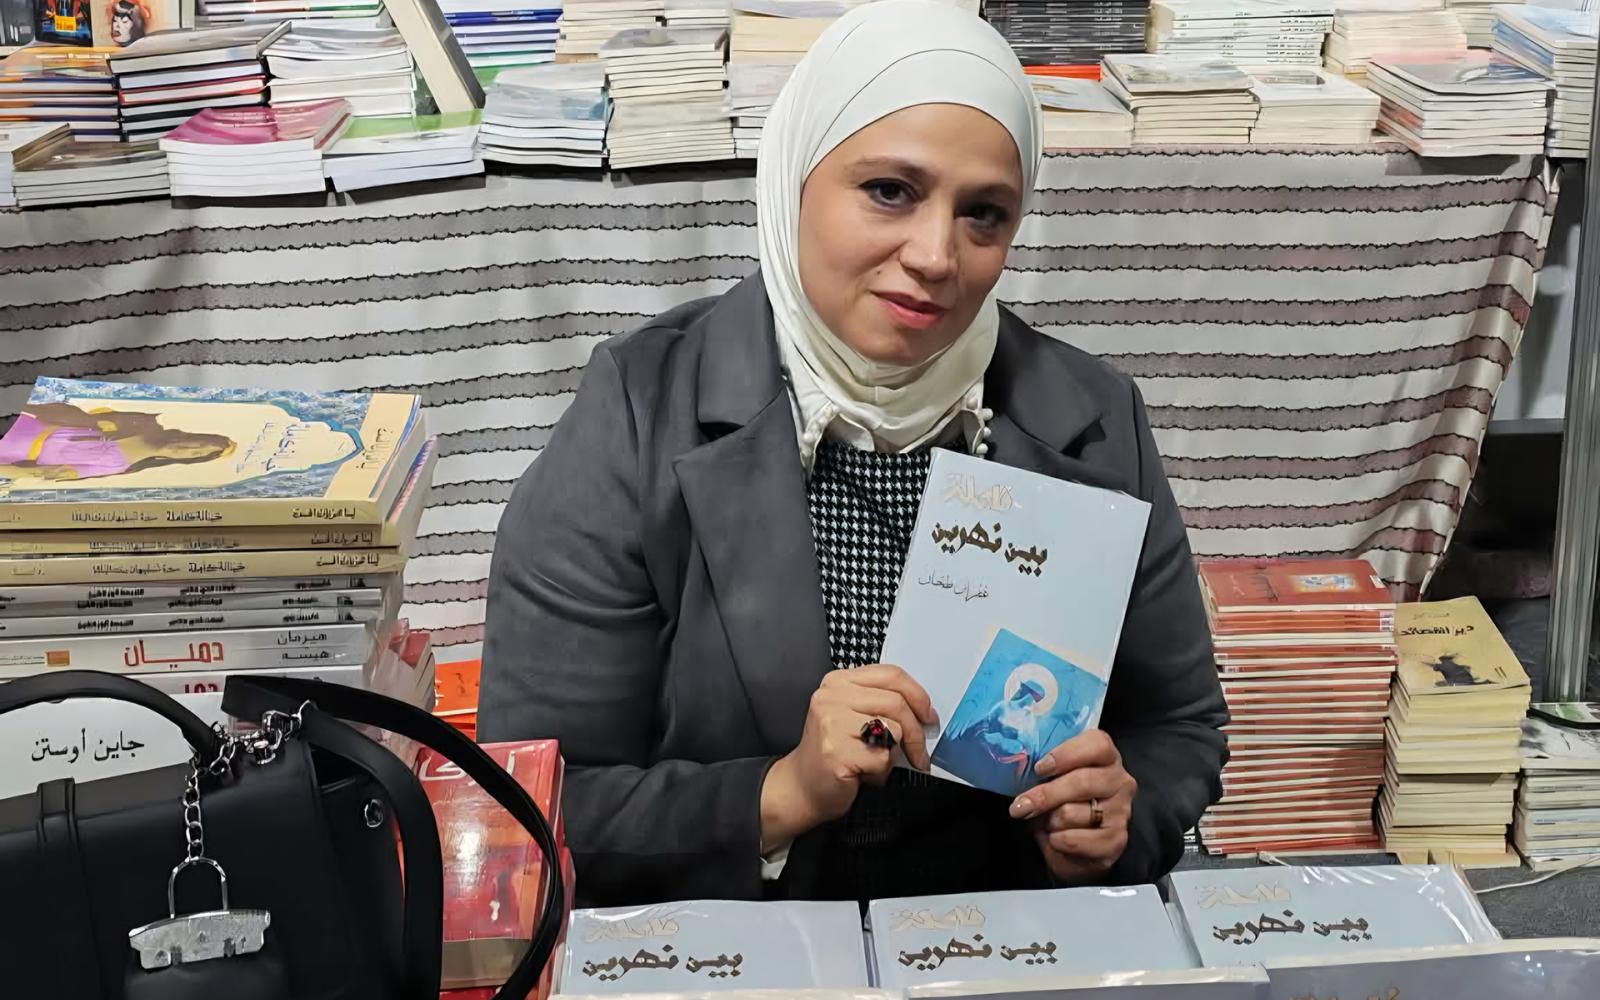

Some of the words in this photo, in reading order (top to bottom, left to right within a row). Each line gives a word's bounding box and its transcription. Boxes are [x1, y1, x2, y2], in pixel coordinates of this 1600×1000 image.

[931, 521, 1002, 554] نهرين
[1004, 543, 1048, 577] بين
[124, 639, 225, 669] دميان
[276, 630, 328, 647] هيرمان
[31, 728, 85, 764] أوستن
[94, 730, 145, 762] جاين
[1212, 908, 1306, 945] نهرين
[1313, 917, 1372, 942] بين
[582, 944, 680, 981] نهرين
[686, 953, 744, 977] بين
[898, 933, 993, 971] نهرين
[1000, 941, 1058, 965] بين
